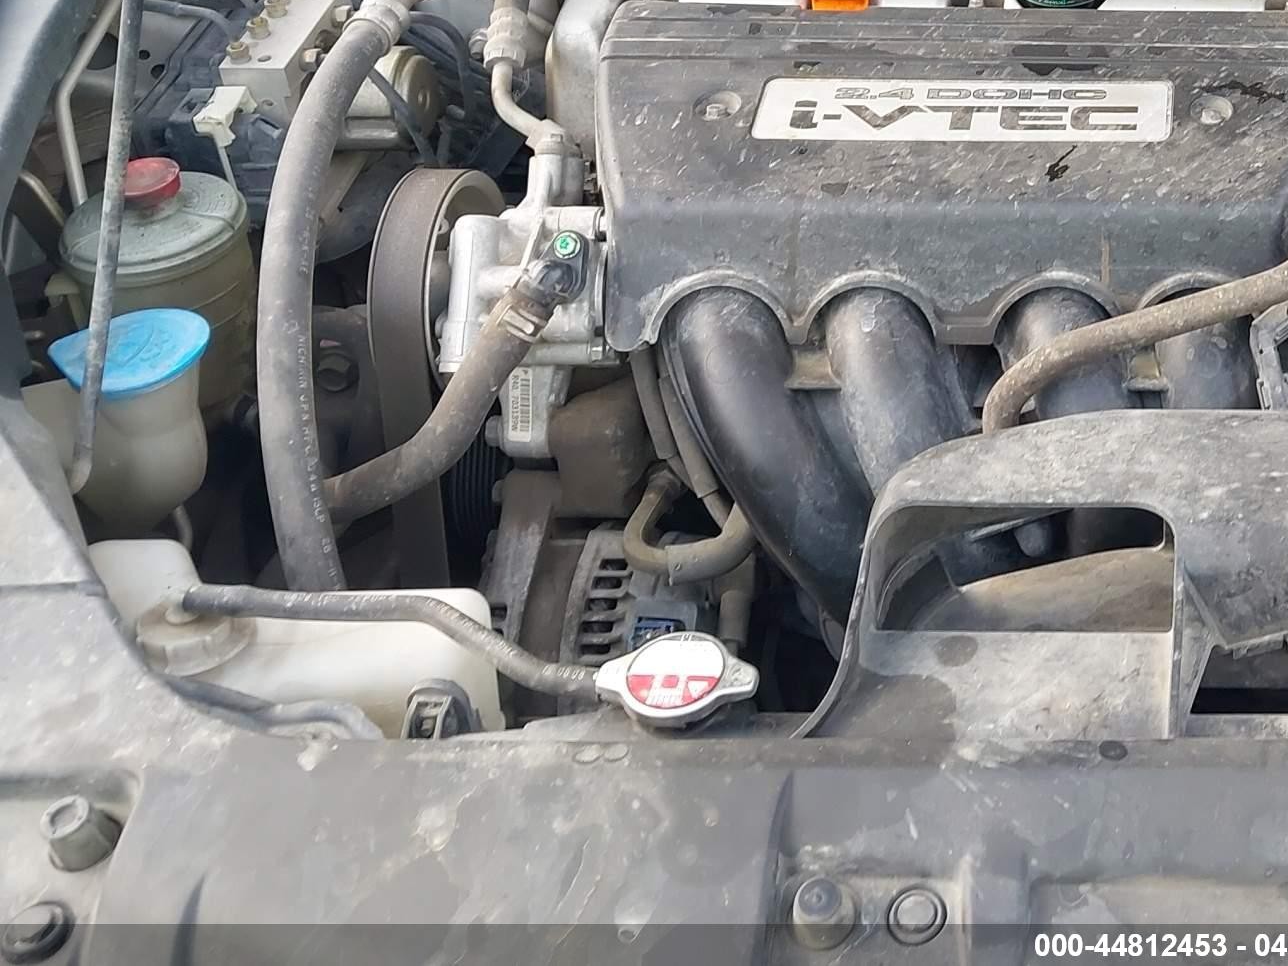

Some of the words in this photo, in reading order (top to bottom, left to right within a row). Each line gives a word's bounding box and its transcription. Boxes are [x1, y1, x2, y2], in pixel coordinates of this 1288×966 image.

[834, 86, 914, 100] 2.4
[927, 87, 1107, 100] DOHC
[790, 99, 1139, 131] i-VTEC
